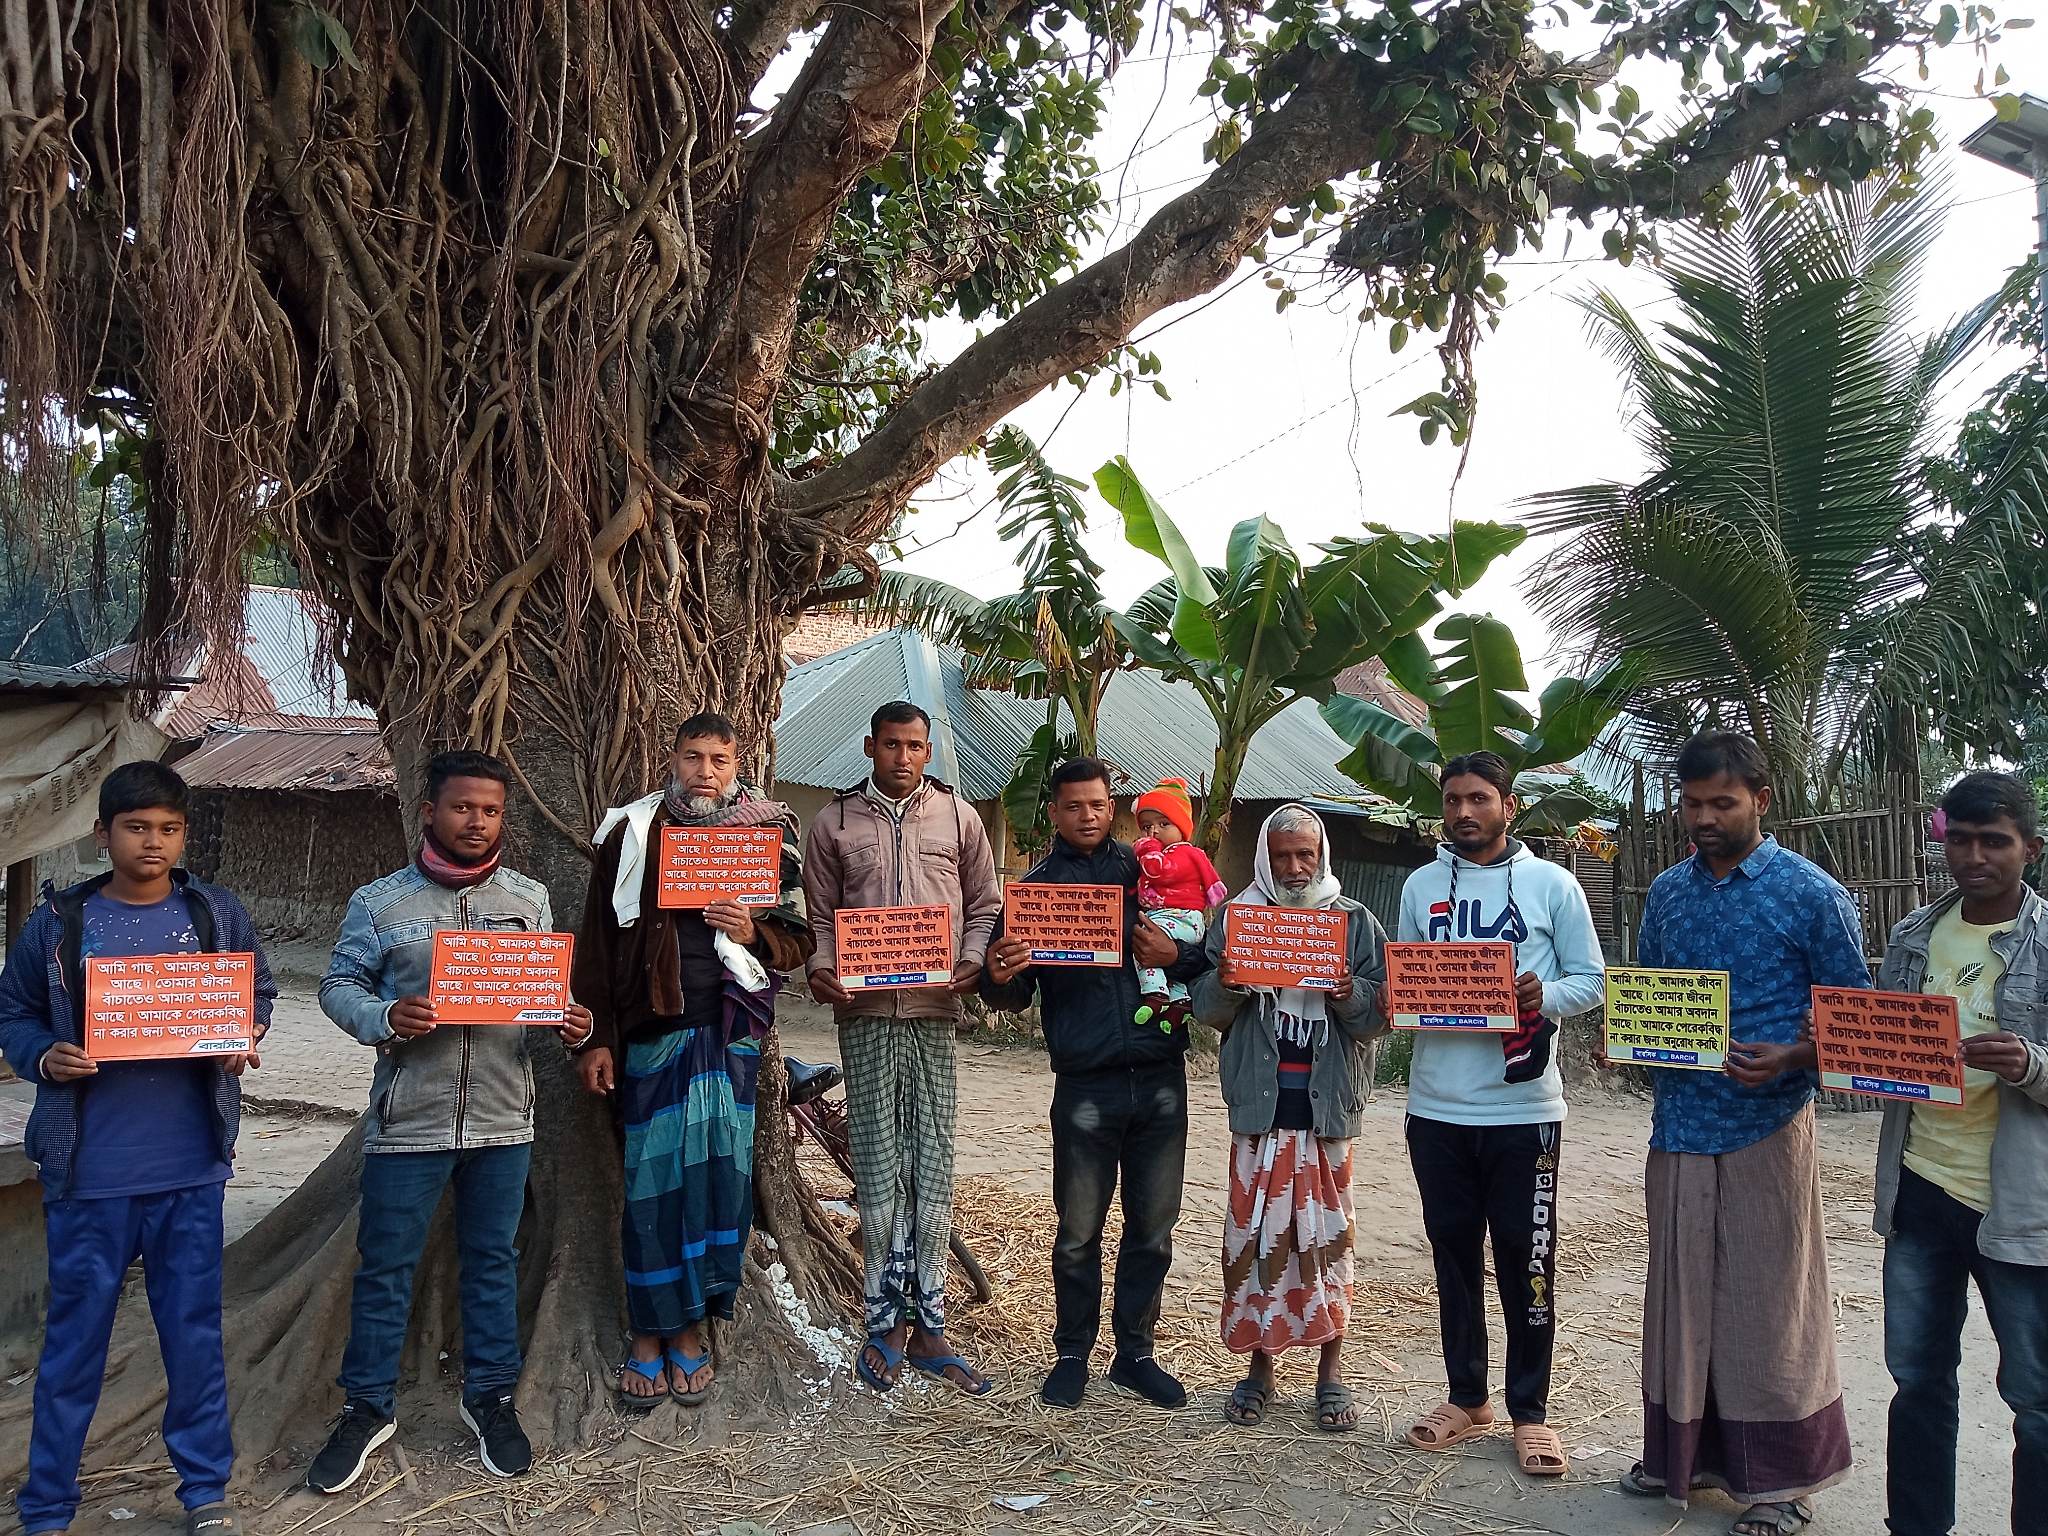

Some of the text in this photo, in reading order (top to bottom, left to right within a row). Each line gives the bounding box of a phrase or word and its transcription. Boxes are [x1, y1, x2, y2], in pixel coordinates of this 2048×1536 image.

[668, 831, 689, 842] আমি
[716, 834, 749, 842] আমারও
[753, 831, 776, 842] জীবন
[710, 846, 739, 854] তোমার
[742, 843, 766, 854] জীবন
[671, 855, 708, 866] বাঁচাতেও
[741, 857, 771, 865] অবদান
[696, 869, 729, 879] আমাকে
[731, 868, 775, 879] পেরেকবিদ্ধ
[1010, 888, 1031, 898] আমি
[1056, 890, 1089, 899] আমারও
[1092, 889, 1116, 900] জীবন
[1051, 903, 1080, 911] তোমার
[1083, 901, 1107, 912] জীবন
[841, 913, 862, 924] আমি
[886, 912, 919, 922] আমারও
[921, 909, 945, 920] জীবন
[1014, 911, 1112, 924] বাঁচাতেও আমার অবদান
[1233, 909, 1254, 919] আমি
[1280, 912, 1313, 922] আমারও
[1317, 913, 1341, 925] জীবন
[1429, 899, 1529, 943] FILA
[882, 926, 910, 935] তোমার
[913, 922, 936, 932] জীবন
[1039, 927, 1070, 936] আমাকে
[1073, 927, 1117, 937] পেরেকবিদ্ধ
[1274, 925, 1304, 935] তোমার
[1307, 925, 1331, 936] জীবন
[442, 936, 567, 950] আমি গাছ, আমারও জীবন
[846, 938, 881, 949] বাঁচাতেও
[913, 936, 942, 945] অবদান
[1237, 932, 1336, 949] বাঁচাতেও আমার অবদান
[489, 953, 524, 963] তোমার
[527, 952, 555, 963] জীবন
[871, 951, 902, 960] আমাকে
[905, 946, 948, 958] পেরেকবিদ্ধ
[1261, 949, 1293, 959] আমাকে
[1296, 951, 1341, 963] পেরেকবিদ্ধ
[1392, 948, 1413, 958] আমি
[1440, 949, 1476, 958] আমারও
[1478, 947, 1505, 959] জীবন
[97, 958, 247, 975] আমি গাছ, আমারও জীবন
[444, 963, 559, 977] বাঁচাতেও আমার অবদান
[1436, 963, 1467, 972] তোমার
[1470, 961, 1496, 972] জীবন
[155, 977, 196, 988] তোমার
[200, 974, 233, 987] জীবন
[473, 982, 510, 991] আমাকে
[513, 980, 563, 992] পেরেকবিদ্ধ
[1398, 973, 1503, 986] বাঁচাতেও আমার অবদান
[1610, 972, 1723, 989] আমি গাছ, আমারও জীবন
[102, 991, 240, 1006] বাঁচাতেও আমার অবদান
[435, 995, 446, 1004] না
[449, 996, 472, 1005] করার
[476, 996, 494, 1005] জন্য
[497, 996, 531, 1007] অনুরোধ
[1425, 989, 1460, 999] আমাকে
[1462, 988, 1511, 1000] পেরেকবিদ্ধ
[1653, 991, 1684, 1002] তোমার
[1686, 990, 1712, 1004] জীবন
[1615, 1000, 1719, 1020] বাঁচাতেও আমার অবদান
[1819, 993, 1843, 1008] আমি
[1875, 999, 1916, 1012] আমারও
[1919, 1000, 1949, 1016] জীবন
[137, 1010, 182, 1021] আমাকে
[186, 1005, 247, 1020] পেরেকবিদ্ধ
[1640, 1019, 1673, 1031] আমাকে
[1676, 1022, 1724, 1035] পেরেকবিদ্ধ
[1870, 1015, 1906, 1028] তোমার
[1909, 1016, 1938, 1032] জীবন
[93, 1030, 105, 1039] না
[110, 1029, 137, 1038] করার
[142, 1027, 163, 1038] জন্য
[167, 1025, 208, 1038] অনুরোধ
[1827, 1024, 1948, 1049] বাঁচাতেও আমার অবদান
[1609, 1032, 1619, 1043] না
[1620, 1034, 1641, 1044] করার
[1644, 1035, 1660, 1046] জন্য
[1663, 1037, 1694, 1050] অনুরোধ
[1858, 1046, 1897, 1060] আমাকে
